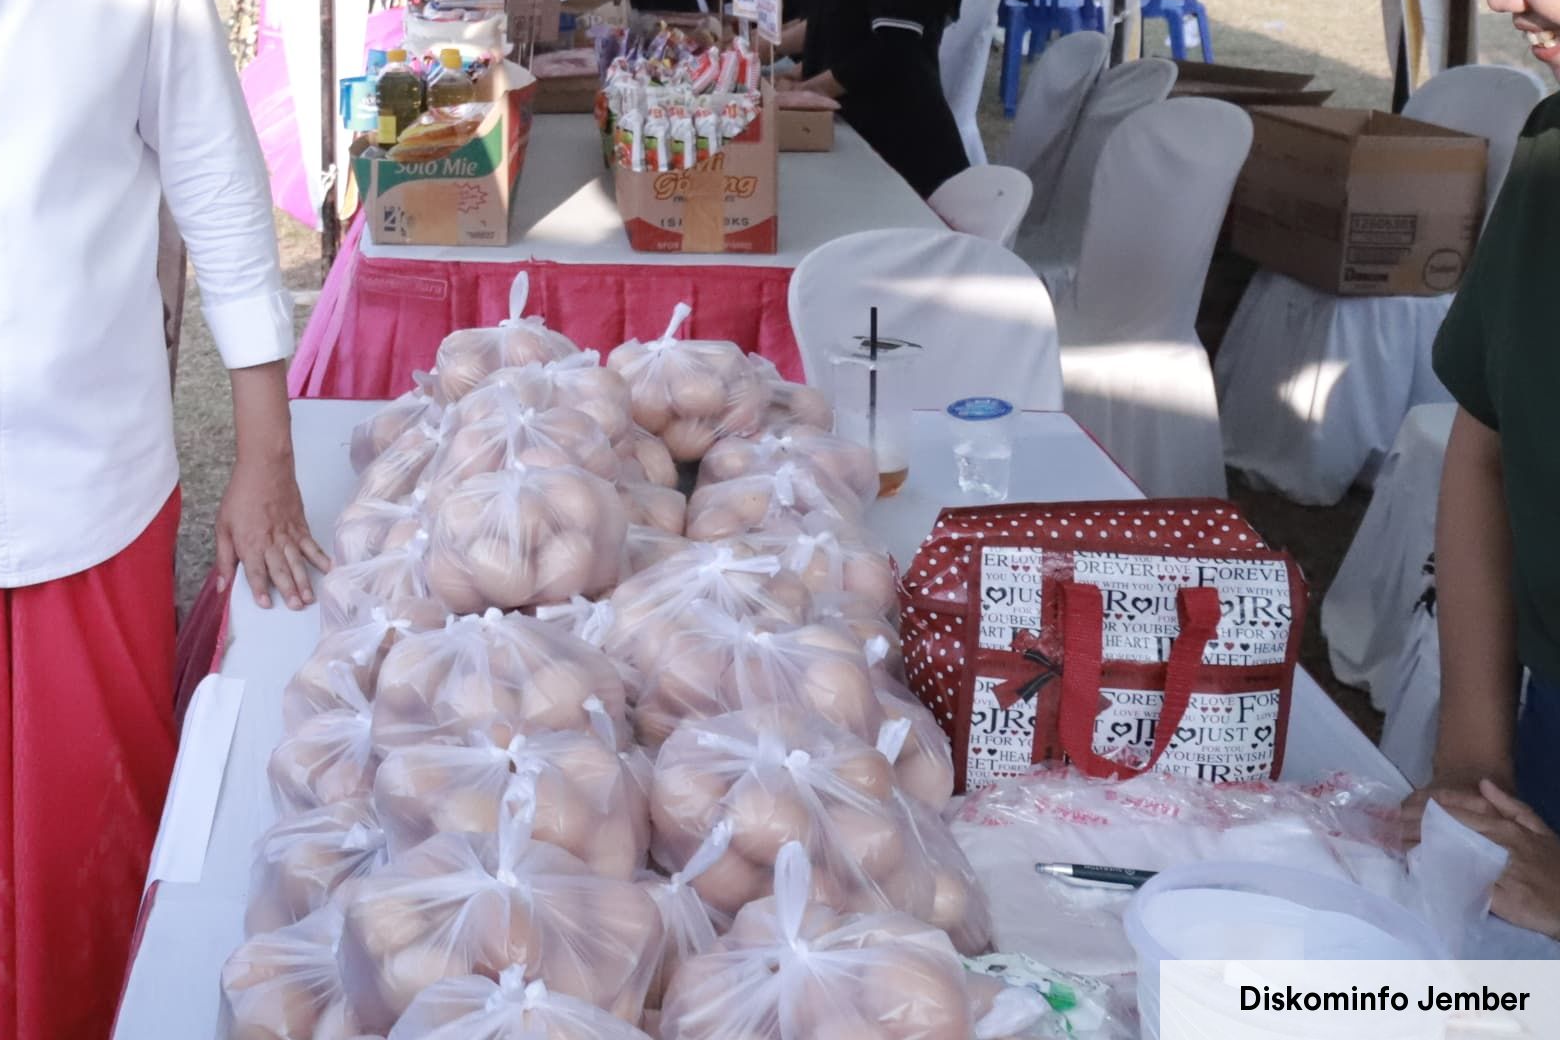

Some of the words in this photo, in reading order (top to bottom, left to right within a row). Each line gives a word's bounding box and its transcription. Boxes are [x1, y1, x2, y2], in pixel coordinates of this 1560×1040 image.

[442, 157, 478, 177] Mie
[654, 171, 758, 201] Gong
[1195, 726, 1249, 746] JUST
